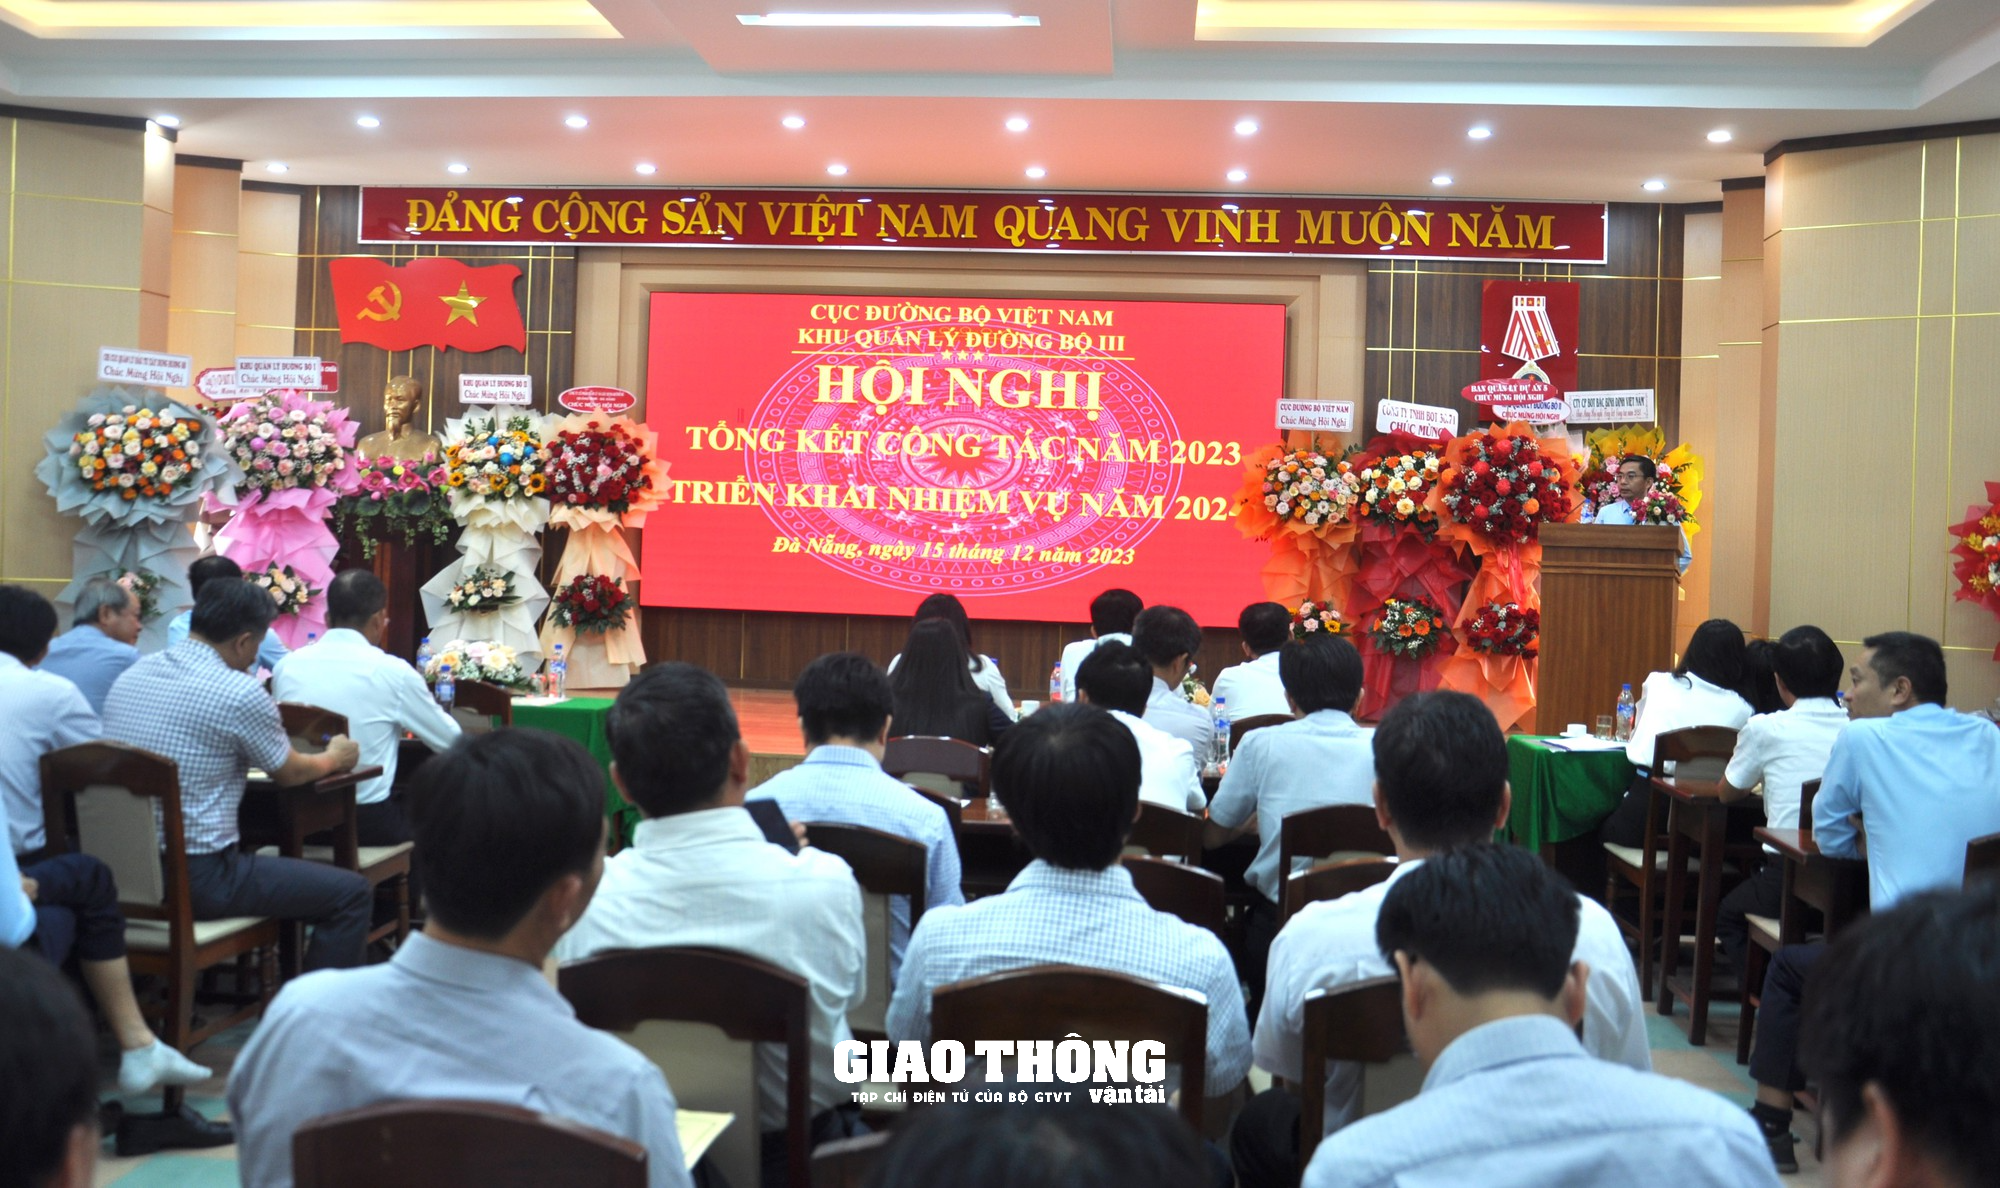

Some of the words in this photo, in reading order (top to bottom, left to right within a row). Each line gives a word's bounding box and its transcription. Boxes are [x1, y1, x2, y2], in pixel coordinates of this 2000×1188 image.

[407, 191, 521, 232] ĐẢNG
[533, 192, 648, 239] CỘNG
[662, 193, 746, 234] SẢN
[759, 194, 863, 242] VIỆT
[876, 205, 977, 237] NAM
[995, 206, 1149, 247] QUANG
[1162, 209, 1280, 243] VINH
[1295, 203, 1434, 246] MUÔN
[1448, 206, 1554, 249] NĂM
[811, 305, 859, 323] CỤC
[866, 302, 951, 322] ĐƯỜNG
[959, 305, 990, 326] BỘ
[997, 307, 1053, 328] VIỆT
[1059, 310, 1112, 326] NAM
[799, 329, 848, 344] KHU
[855, 326, 921, 348] QUẢN
[928, 328, 959, 346] LÝ
[966, 328, 1052, 349] ĐƯỜNG
[1058, 332, 1092, 354] BỘ
[1099, 336, 1124, 351] III
[814, 360, 928, 415] HỘI
[944, 368, 1105, 421] NGHỊ
[1281, 415, 1297, 424] Chúc
[1410, 409, 1424, 421] TNHH
[686, 421, 786, 452] TỔNG
[796, 424, 868, 454] KẾT
[877, 425, 982, 458] CÔNG
[991, 428, 1065, 462] TÁC
[1075, 432, 1160, 463] NĂM
[1170, 439, 1240, 465] 2023
[672, 475, 776, 506] TRIỂN
[786, 484, 877, 509] KHAI
[887, 483, 1010, 518] NHIỆM
[1020, 491, 1070, 521] VỤ
[1079, 488, 1165, 519] NĂM
[1175, 496, 1237, 520] 202
[773, 537, 800, 552] Đà
[806, 534, 862, 558] Nẵng,
[869, 541, 915, 560] ngày
[921, 542, 944, 557] 15
[949, 543, 1005, 564] tháng
[1011, 545, 1034, 561] 12
[1039, 547, 1081, 562] năm
[1088, 548, 1134, 564] 2023
